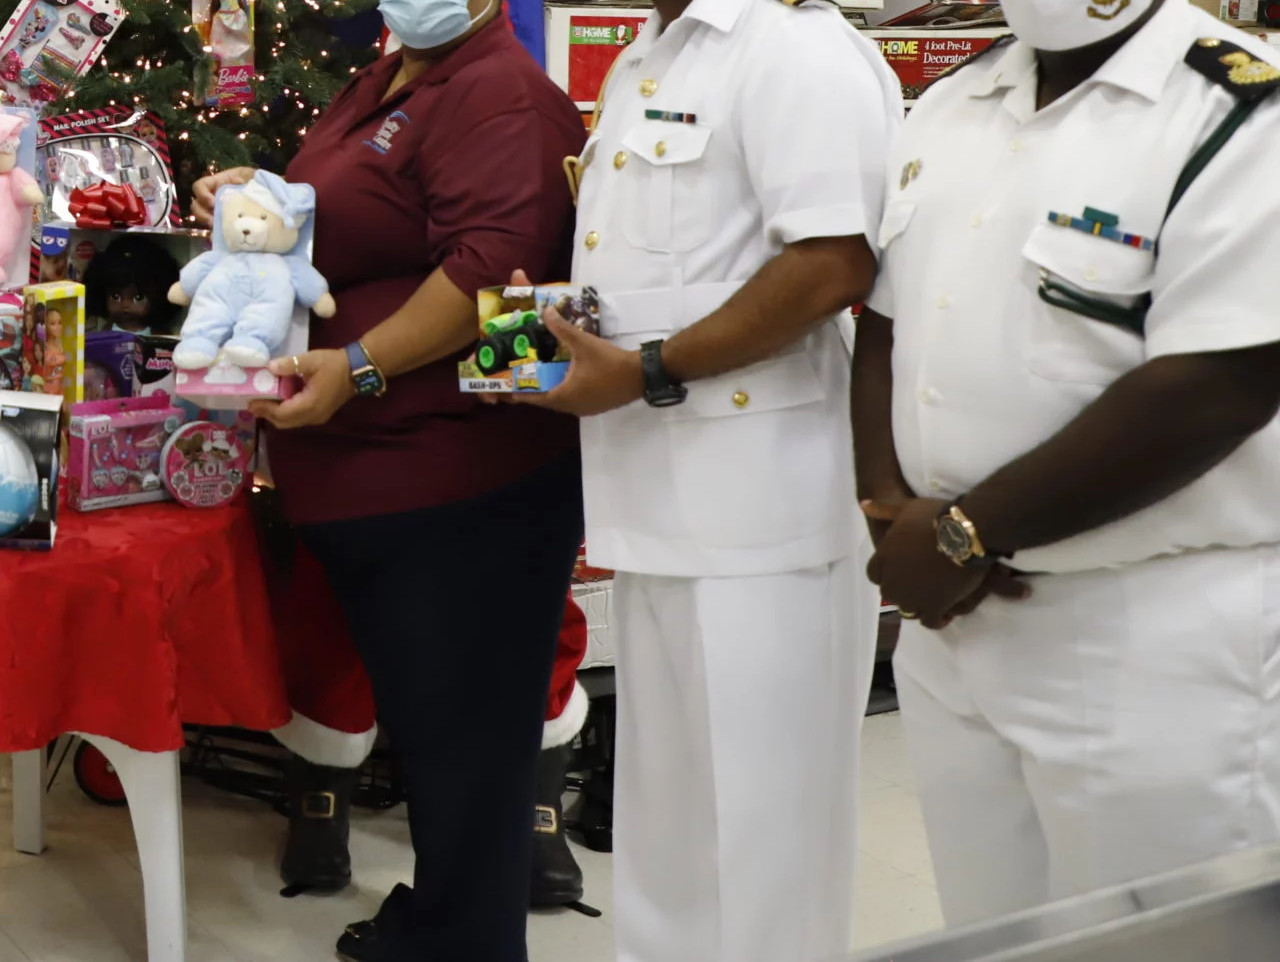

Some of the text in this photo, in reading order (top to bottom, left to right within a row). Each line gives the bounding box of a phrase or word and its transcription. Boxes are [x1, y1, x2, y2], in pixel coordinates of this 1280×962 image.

[931, 40, 945, 50] foot
[947, 40, 972, 50] Pre-Lit
[53, 115, 110, 131] NAIL POLISH SET
